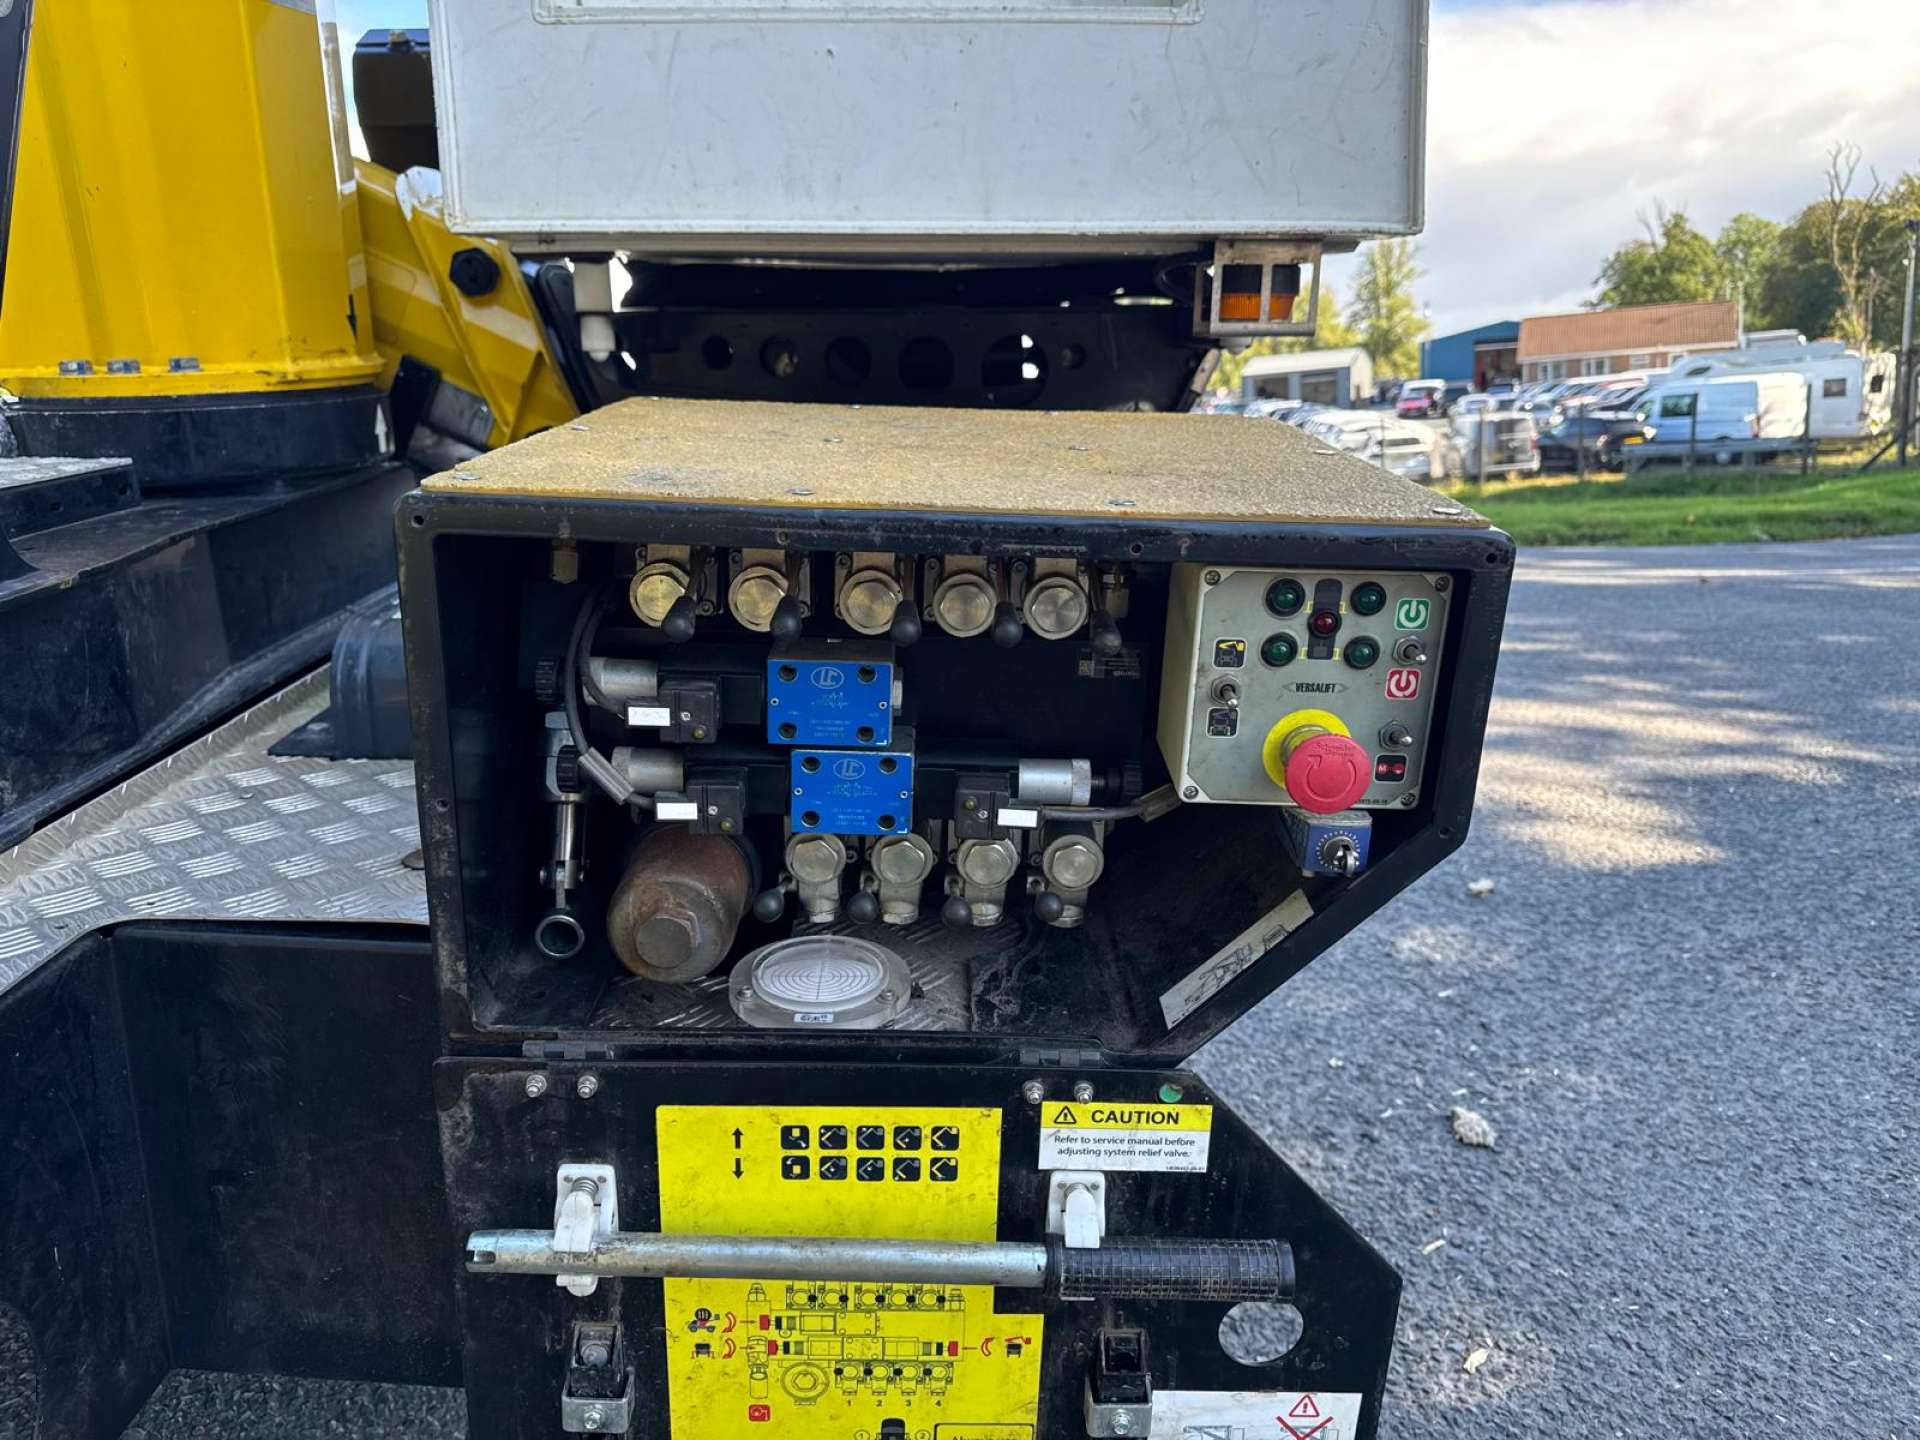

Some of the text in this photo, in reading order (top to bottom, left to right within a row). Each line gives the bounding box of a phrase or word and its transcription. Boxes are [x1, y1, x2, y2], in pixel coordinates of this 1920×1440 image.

[1295, 682, 1337, 694] VERSALIFT
[1091, 1109, 1180, 1125] CAUTION
[1054, 1134, 1196, 1147] Refer to service manual before
[1057, 1147, 1101, 1157] adjusting
[1103, 1149, 1136, 1157] system
[1138, 1148, 1163, 1157] relief
[847, 1399, 942, 1407] 1 2 3 4
